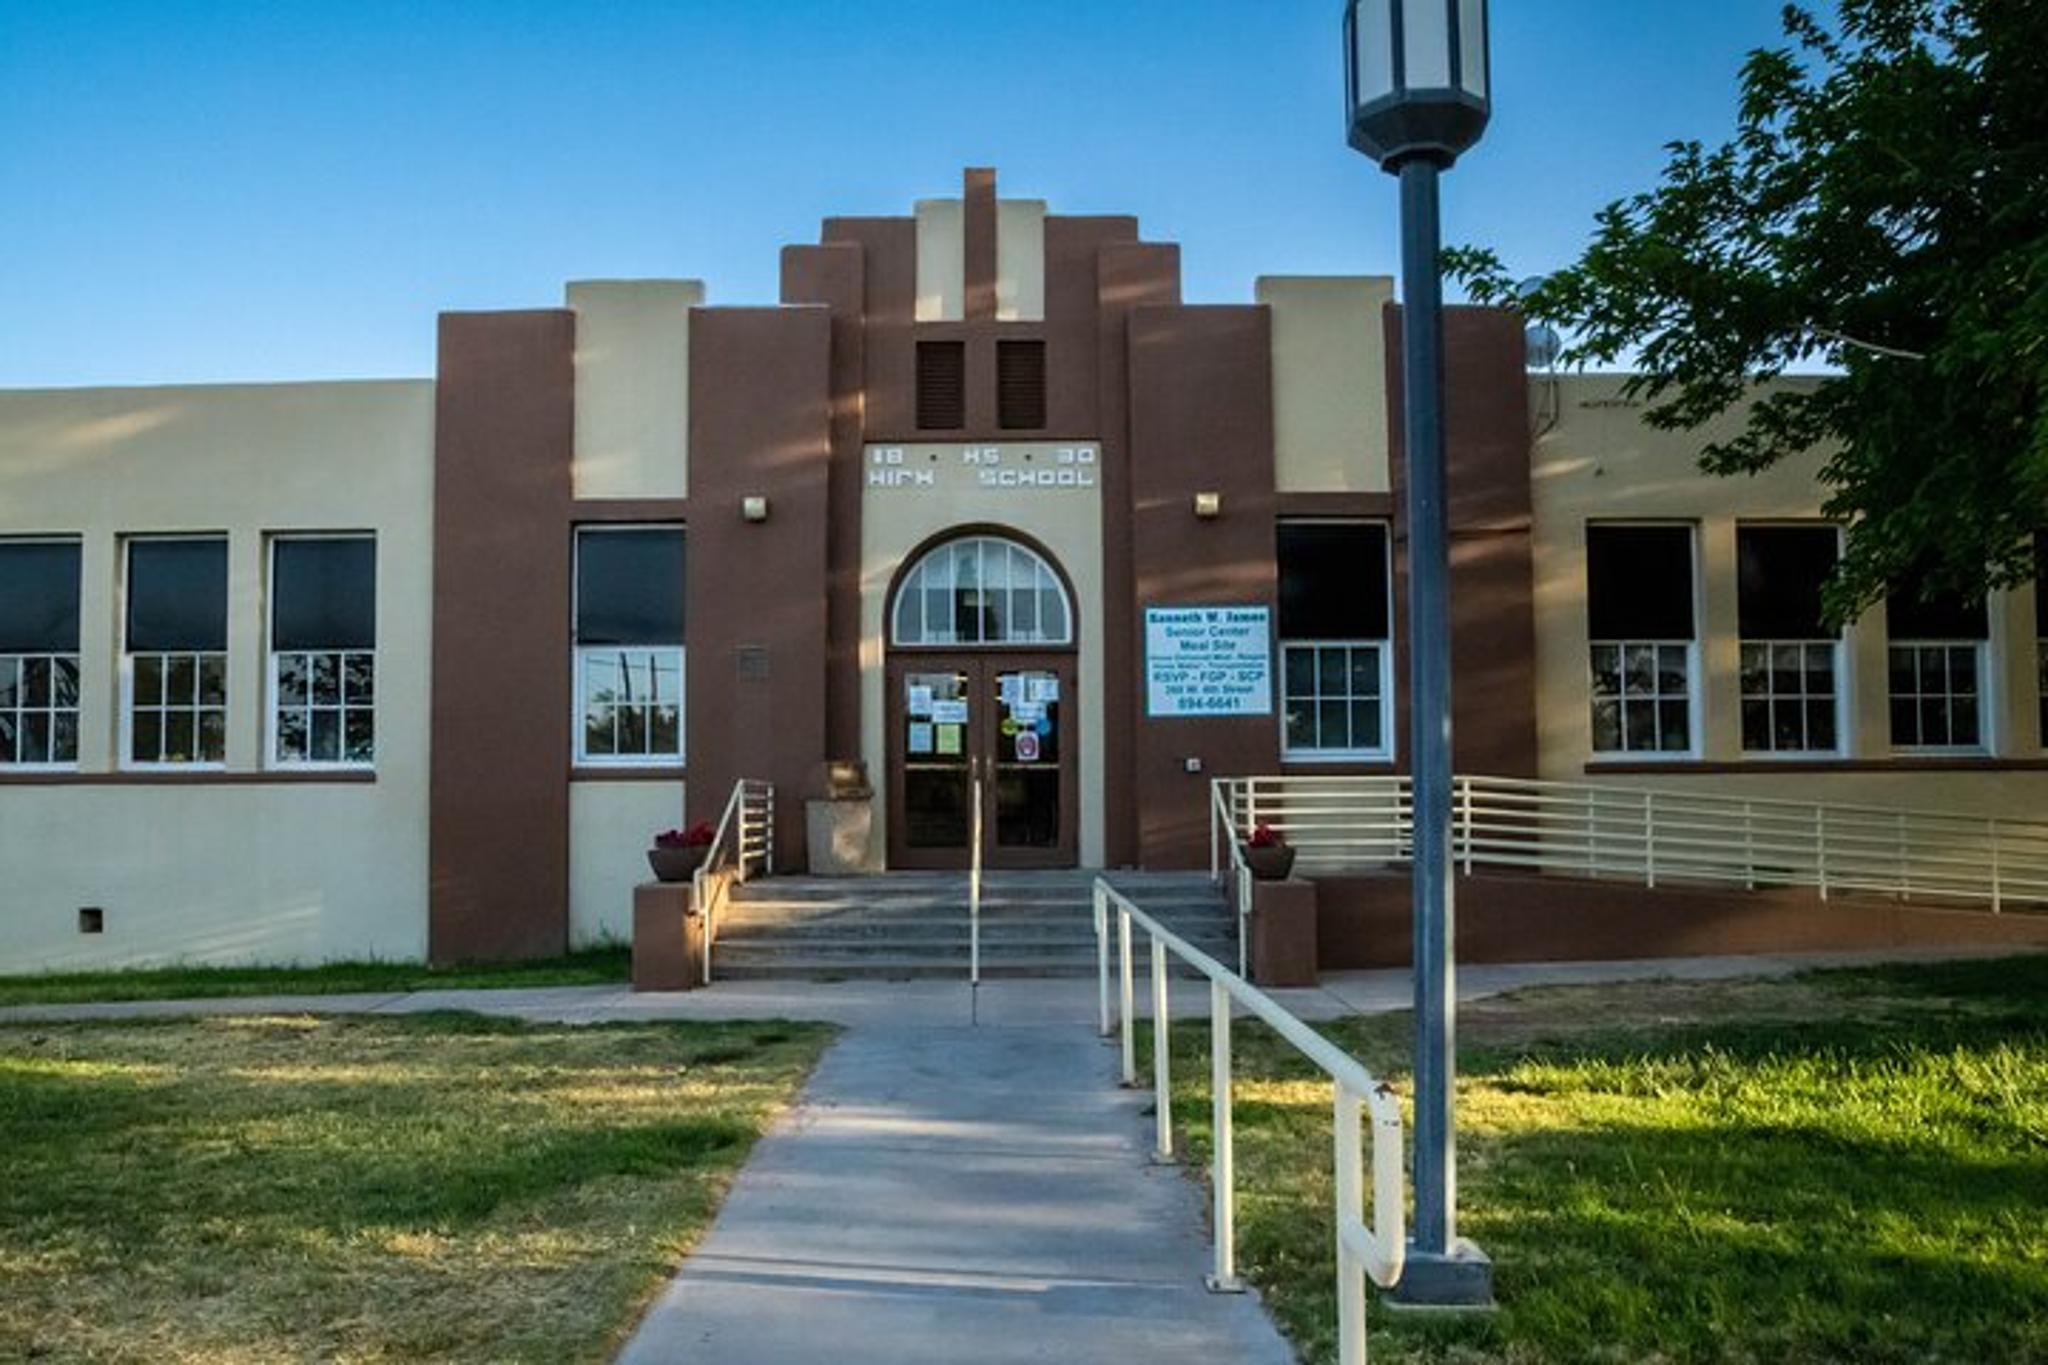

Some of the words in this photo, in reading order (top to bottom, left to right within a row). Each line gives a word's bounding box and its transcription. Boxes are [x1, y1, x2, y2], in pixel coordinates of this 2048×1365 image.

[979, 469, 1094, 485] SCHOOL
[1149, 612, 1202, 623] Kenneth
[1165, 627, 1206, 637] Senior
[1209, 626, 1250, 637] Center
[1180, 640, 1209, 650] Meal
[1213, 640, 1236, 650] Site
[1153, 671, 1189, 682] RSVP
[1200, 671, 1227, 682] FGP
